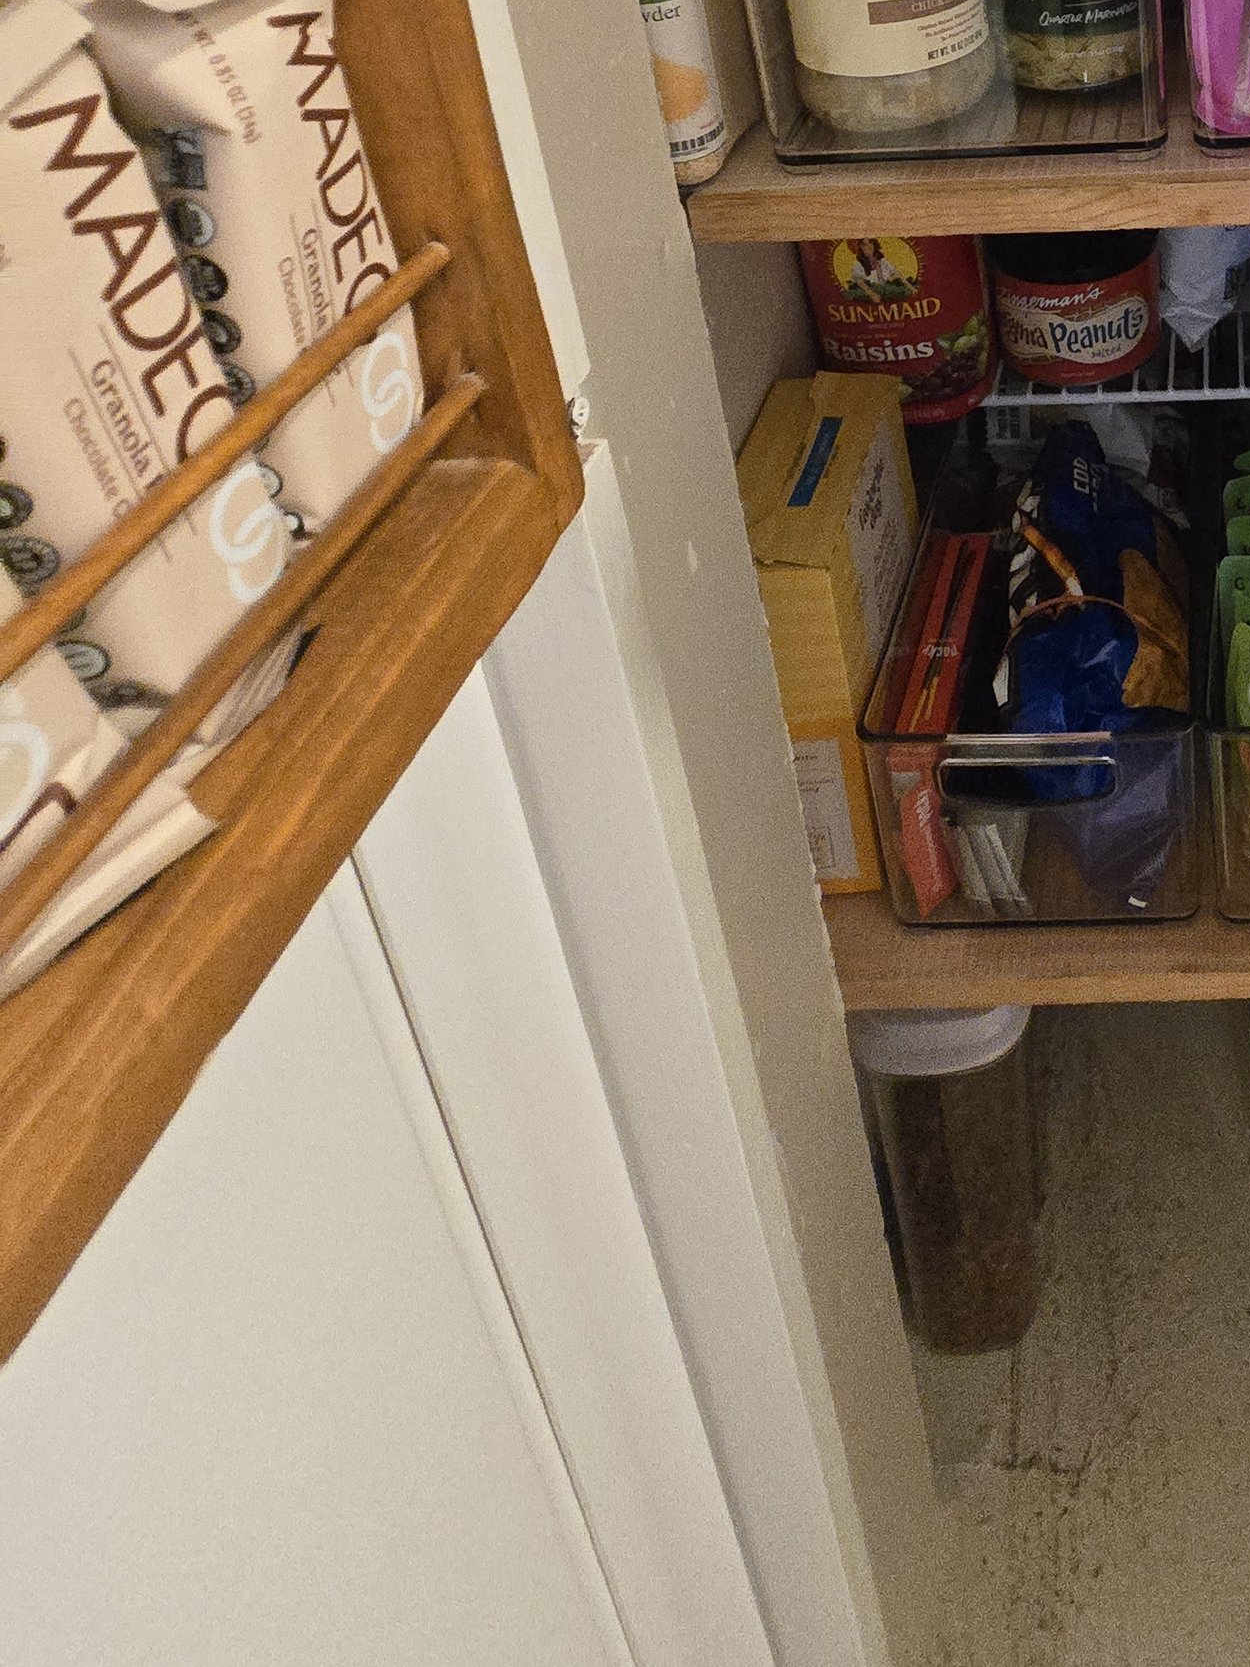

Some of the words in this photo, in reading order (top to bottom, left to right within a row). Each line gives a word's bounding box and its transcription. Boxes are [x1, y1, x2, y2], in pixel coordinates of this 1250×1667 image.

[208, 54, 232, 86] 0.85
[226, 85, 243, 108] OZ
[277, 255, 308, 348] Chocolate
[302, 226, 330, 334] Granola
[822, 338, 935, 364] Raisins
[1049, 306, 1144, 354] Peanuts
[1091, 342, 1123, 359] salted
[64, 397, 120, 502] Chocolate
[90, 359, 153, 480] Granola
